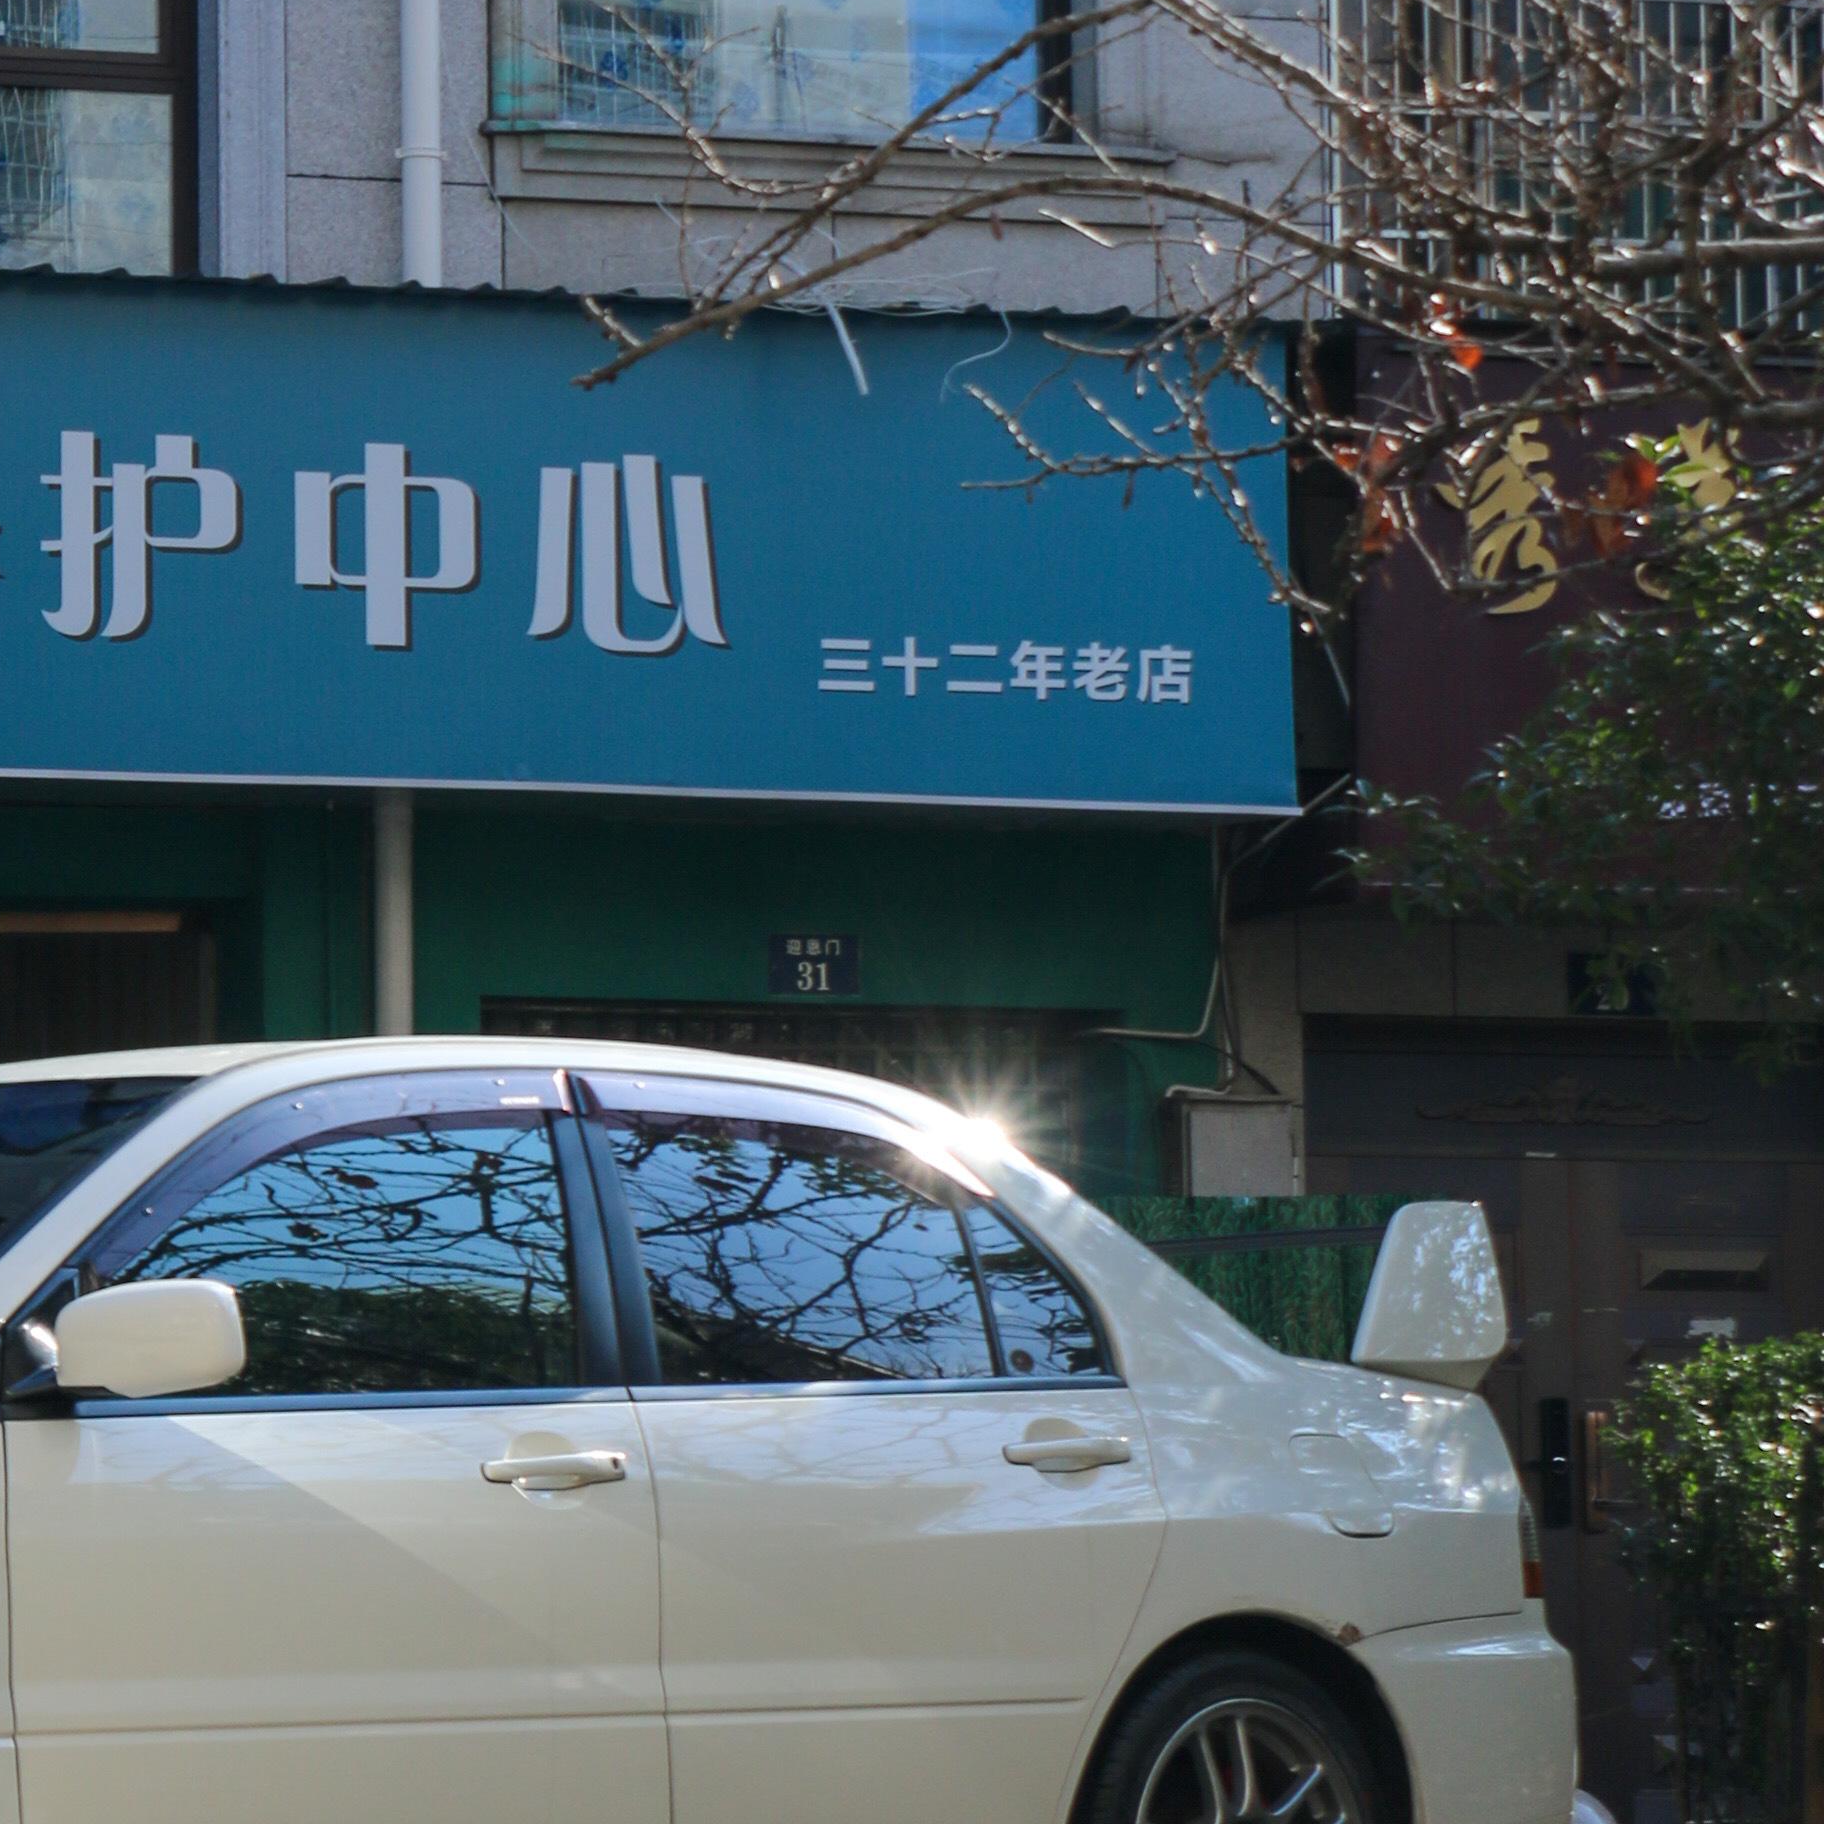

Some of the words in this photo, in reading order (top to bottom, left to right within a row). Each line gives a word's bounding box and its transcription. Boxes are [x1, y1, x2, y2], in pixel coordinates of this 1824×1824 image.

[817, 636, 1193, 704] 三十二年老店
[797, 961, 831, 991] 31
